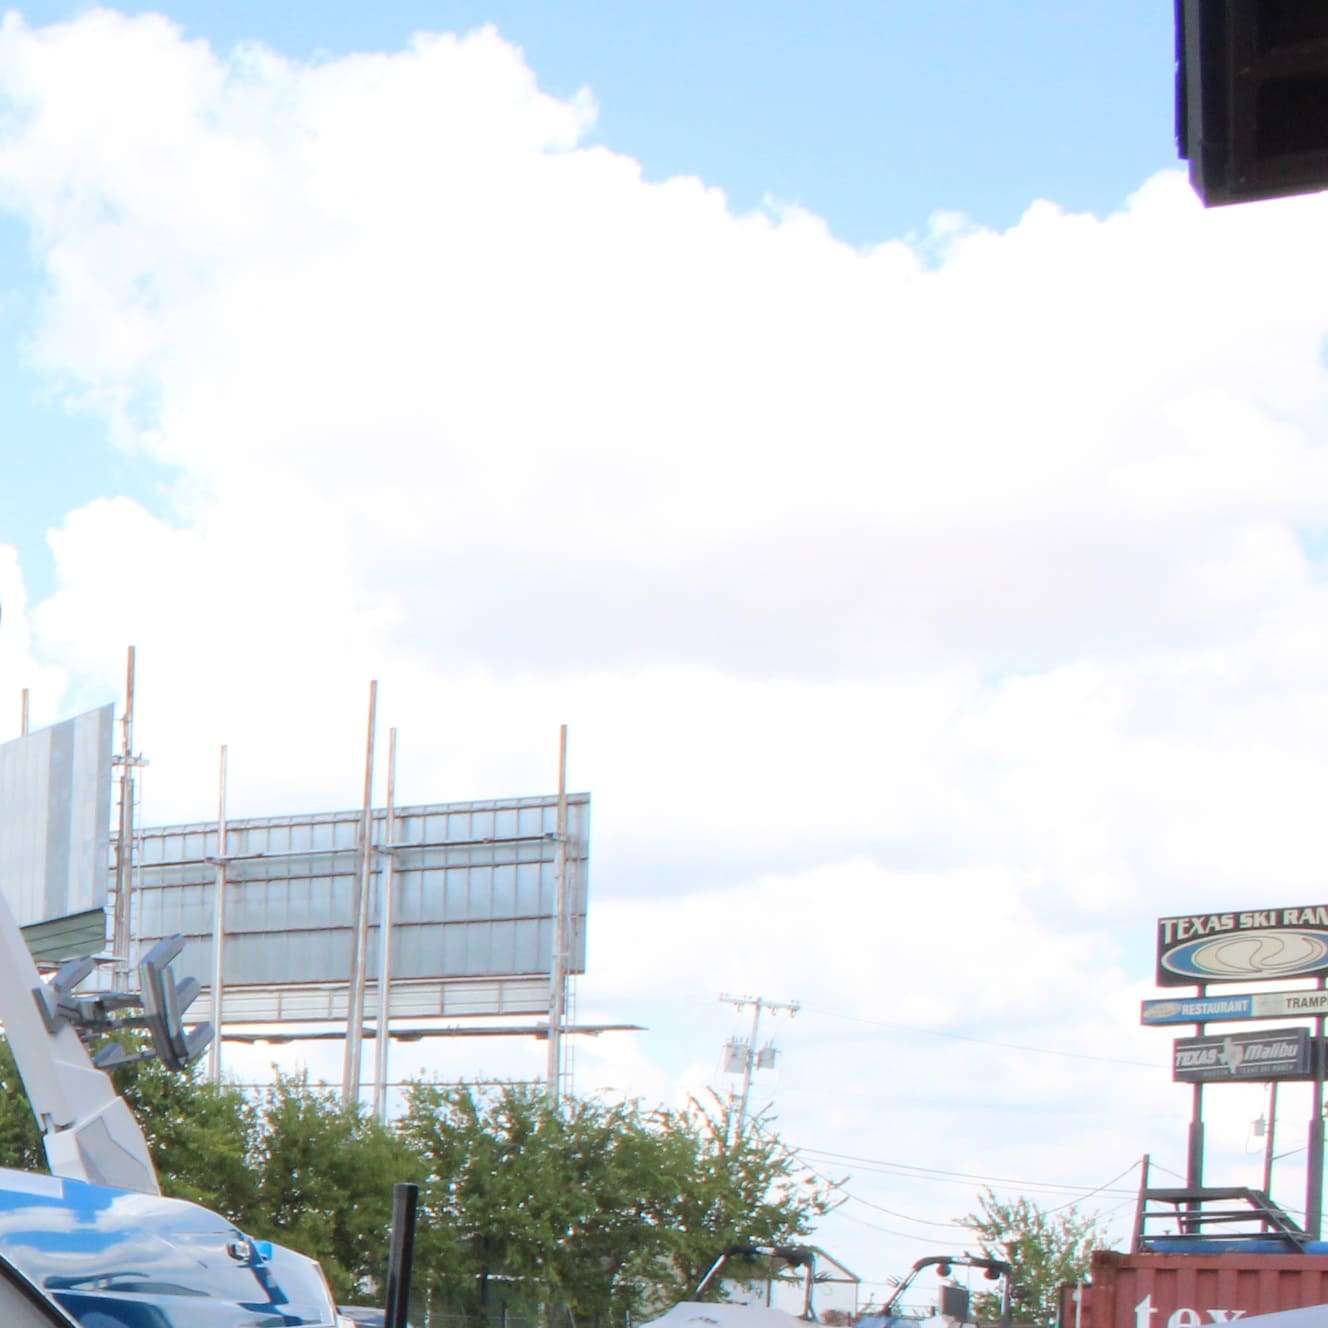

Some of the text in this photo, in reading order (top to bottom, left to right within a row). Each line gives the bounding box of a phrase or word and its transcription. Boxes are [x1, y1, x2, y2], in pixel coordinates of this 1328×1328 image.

[1160, 914, 1235, 945] TEXAS
[1239, 911, 1276, 929] SKI
[1181, 1000, 1249, 1015] RESTAURANT
[1285, 996, 1328, 1009] TRAMP
[1176, 1043, 1299, 1067] TEXAS Malibu
